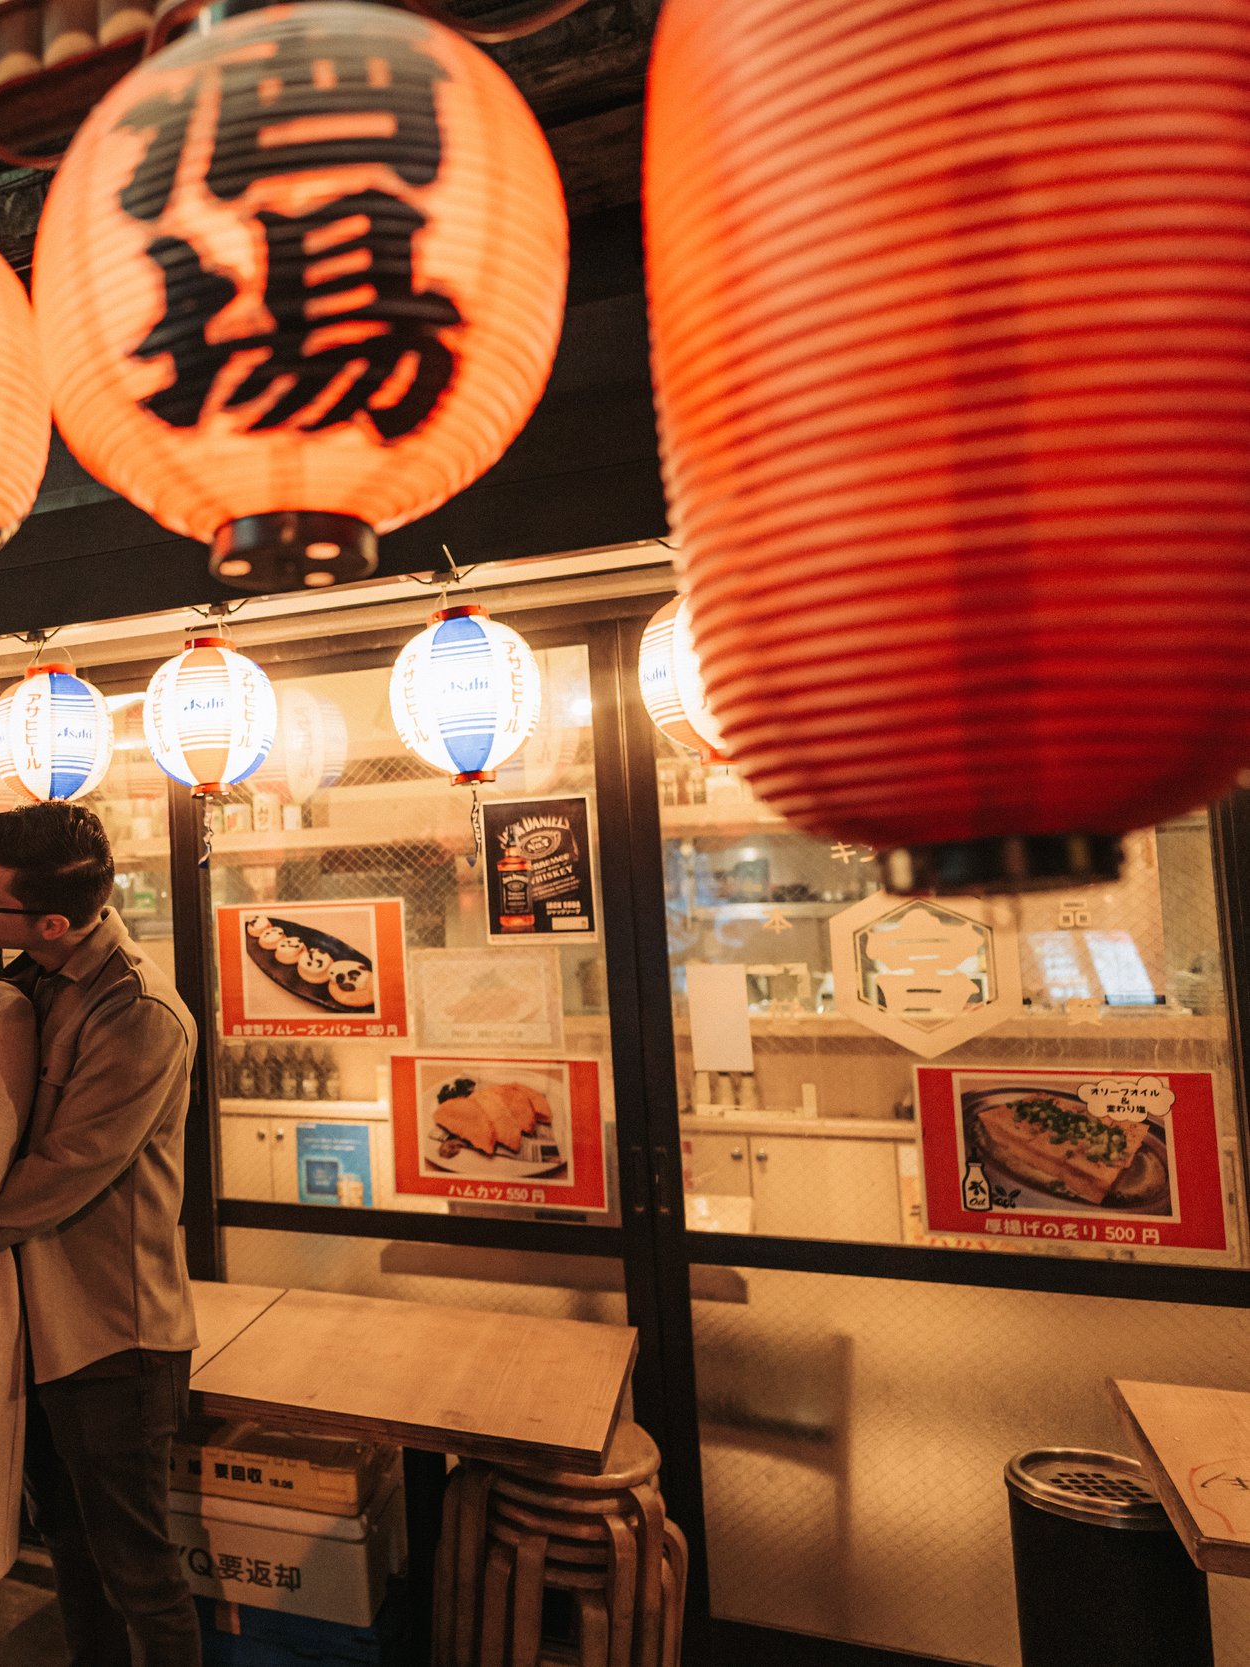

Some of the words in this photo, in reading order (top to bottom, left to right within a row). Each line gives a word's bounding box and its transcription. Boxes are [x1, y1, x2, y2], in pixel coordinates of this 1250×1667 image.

[184, 697, 225, 711] Asahi
[25, 693, 42, 771] アサヒビール
[56, 726, 93, 739] Asahi
[386, 1024, 398, 1036] 円
[448, 1184, 503, 1199] ハムカツ
[506, 1188, 529, 1200] 550
[531, 1189, 545, 1203] 円
[1105, 1226, 1136, 1242] 500
[1142, 1229, 1160, 1245] 円
